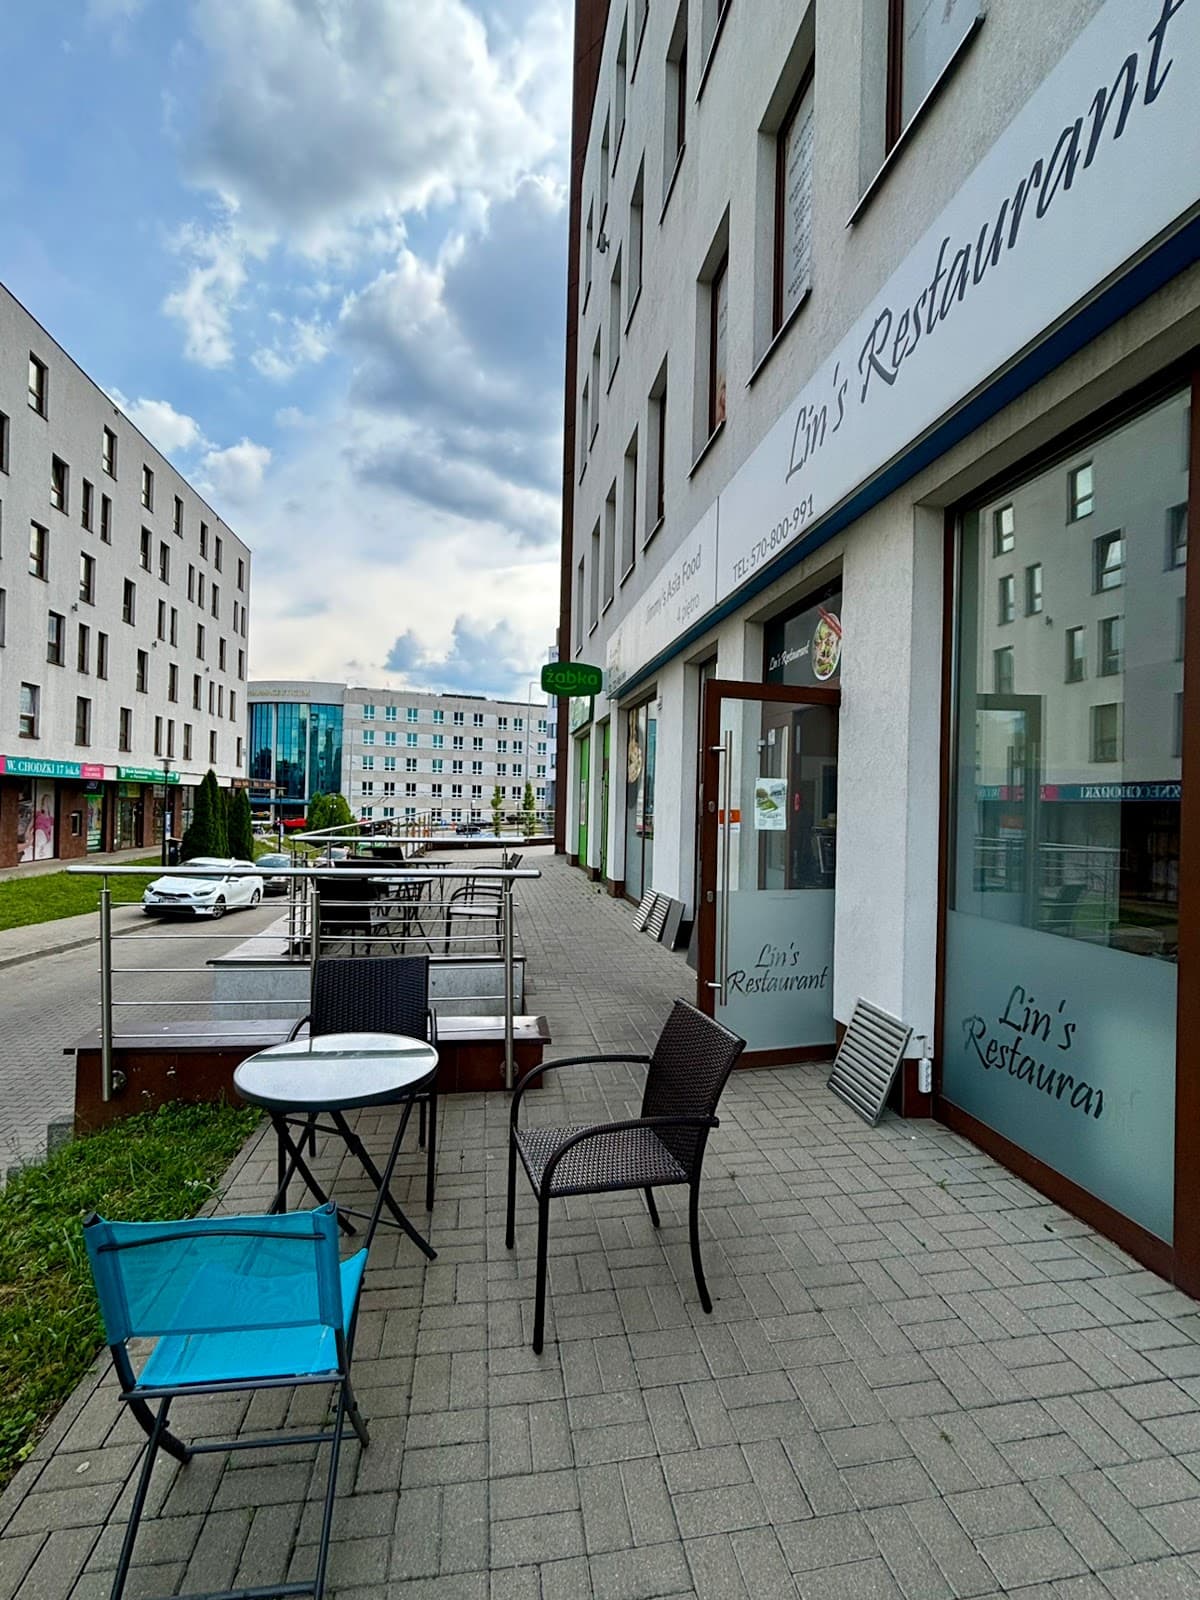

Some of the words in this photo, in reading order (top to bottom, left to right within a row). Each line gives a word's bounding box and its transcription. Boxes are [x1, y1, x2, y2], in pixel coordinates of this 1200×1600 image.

[785, 362, 848, 484] Lin's
[857, 0, 1186, 404] Restaurant
[733, 557, 749, 582] TEL:
[751, 493, 814, 567] 570-800-991
[666, 572, 681, 601] Asia
[682, 543, 702, 585] Food
[546, 668, 598, 686] żabka
[7, 760, 17, 771] W.
[754, 942, 801, 969] Lin's
[726, 965, 829, 997] Restaurant
[998, 984, 1077, 1050] Lin's
